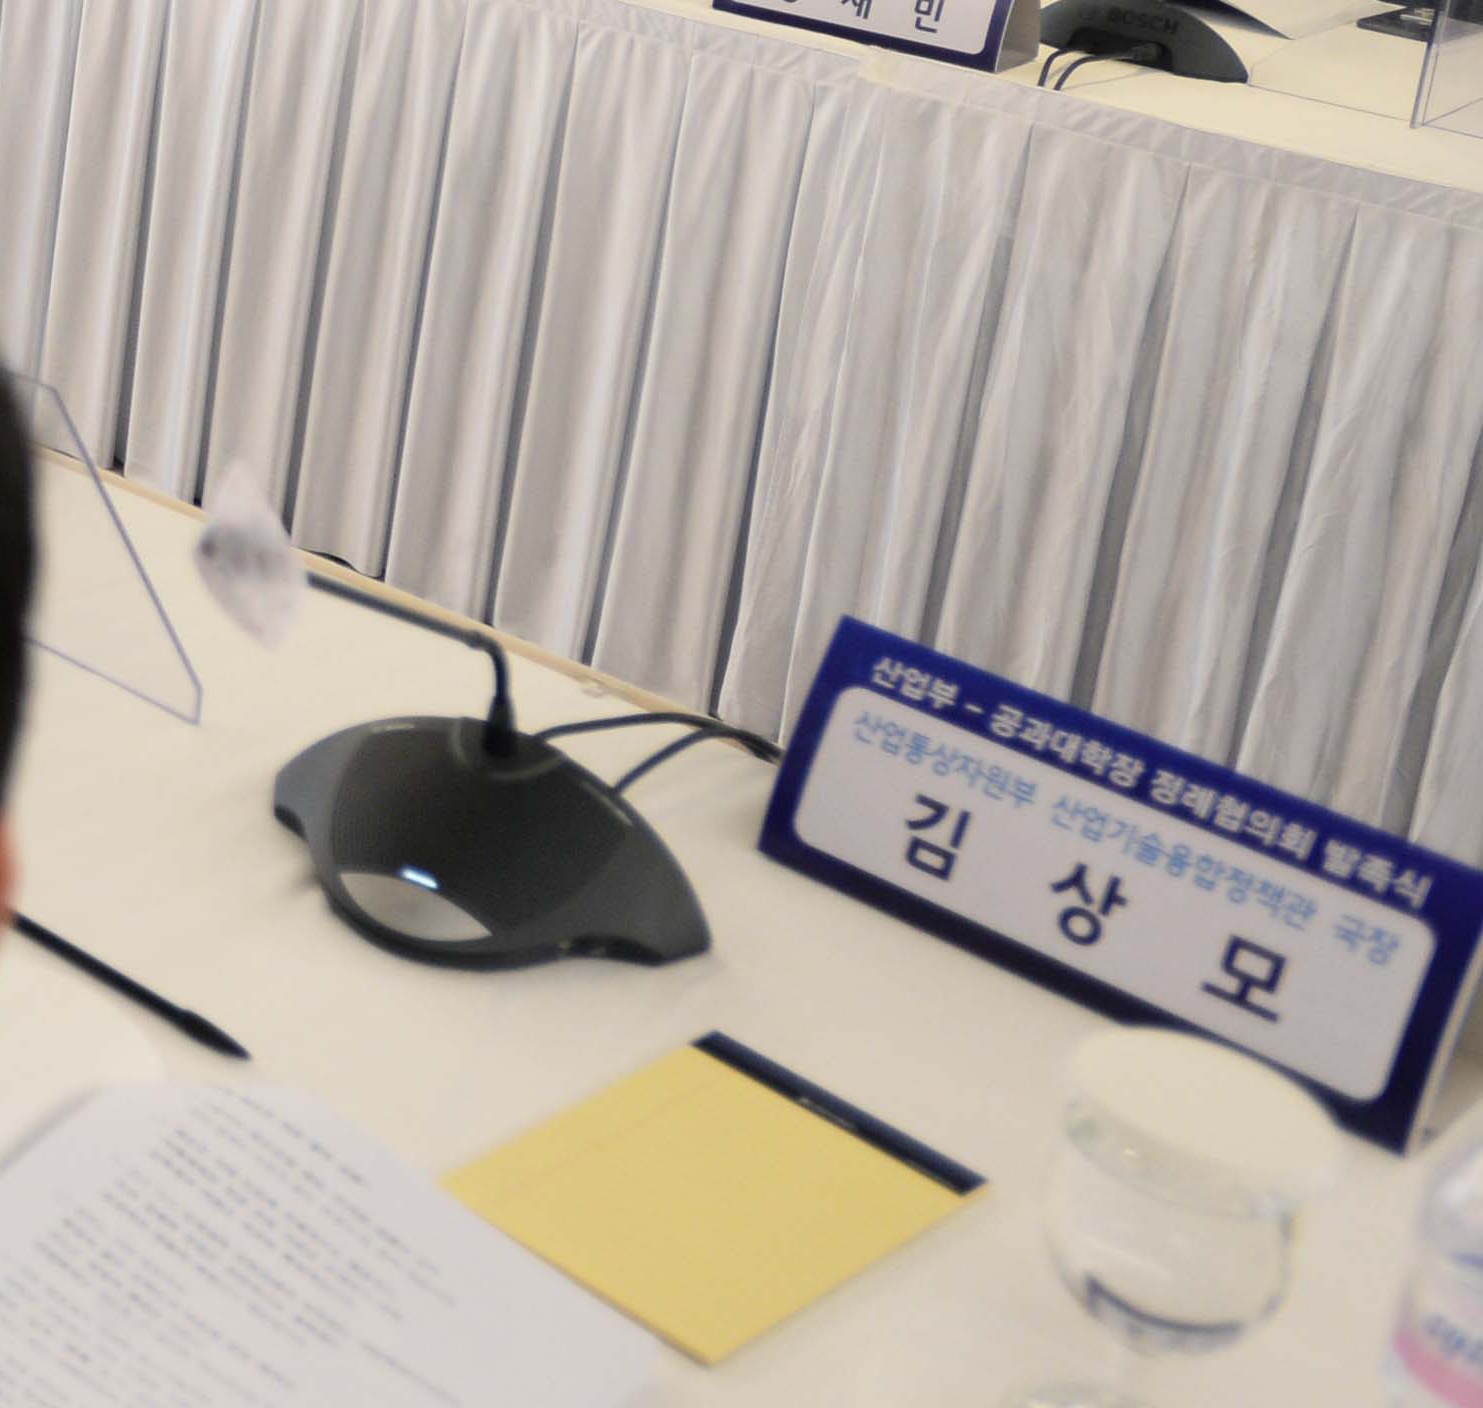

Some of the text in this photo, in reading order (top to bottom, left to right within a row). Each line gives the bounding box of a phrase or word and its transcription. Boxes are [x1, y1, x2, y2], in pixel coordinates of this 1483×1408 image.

[854, 710, 1038, 809] 산업통상자원부
[1333, 912, 1401, 967] 국장
[872, 657, 959, 709] 산업부
[990, 703, 1146, 789] 공과대학장
[1149, 768, 1318, 862] 정례협의회
[1322, 837, 1434, 910] 발족식
[903, 792, 1288, 1024] 김 상 모
